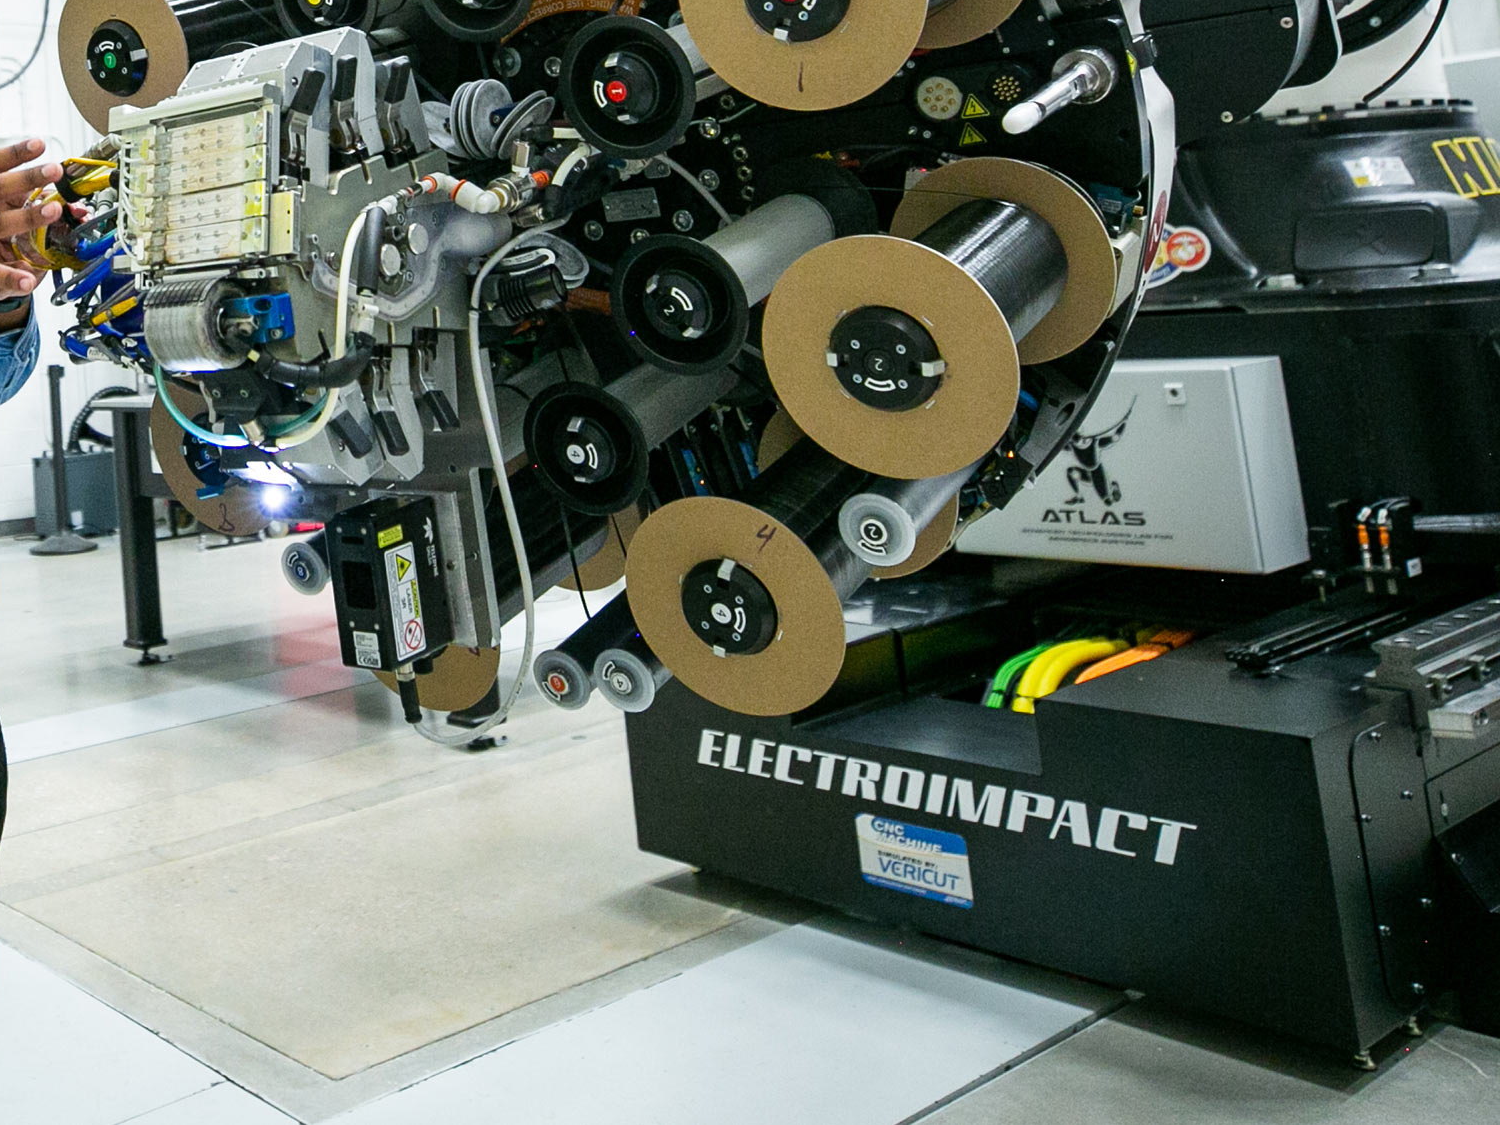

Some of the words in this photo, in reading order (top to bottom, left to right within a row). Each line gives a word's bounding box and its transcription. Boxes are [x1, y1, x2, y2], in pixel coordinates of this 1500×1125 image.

[1041, 509, 1147, 527] ATLAS
[756, 523, 778, 553] 4
[401, 597, 408, 609] 3R
[405, 587, 414, 614] LASER
[697, 728, 1199, 866] ELECTROIMPACT
[873, 820, 905, 836] CNC
[877, 832, 942, 853] MACHINE
[878, 856, 961, 890] VERICUT
